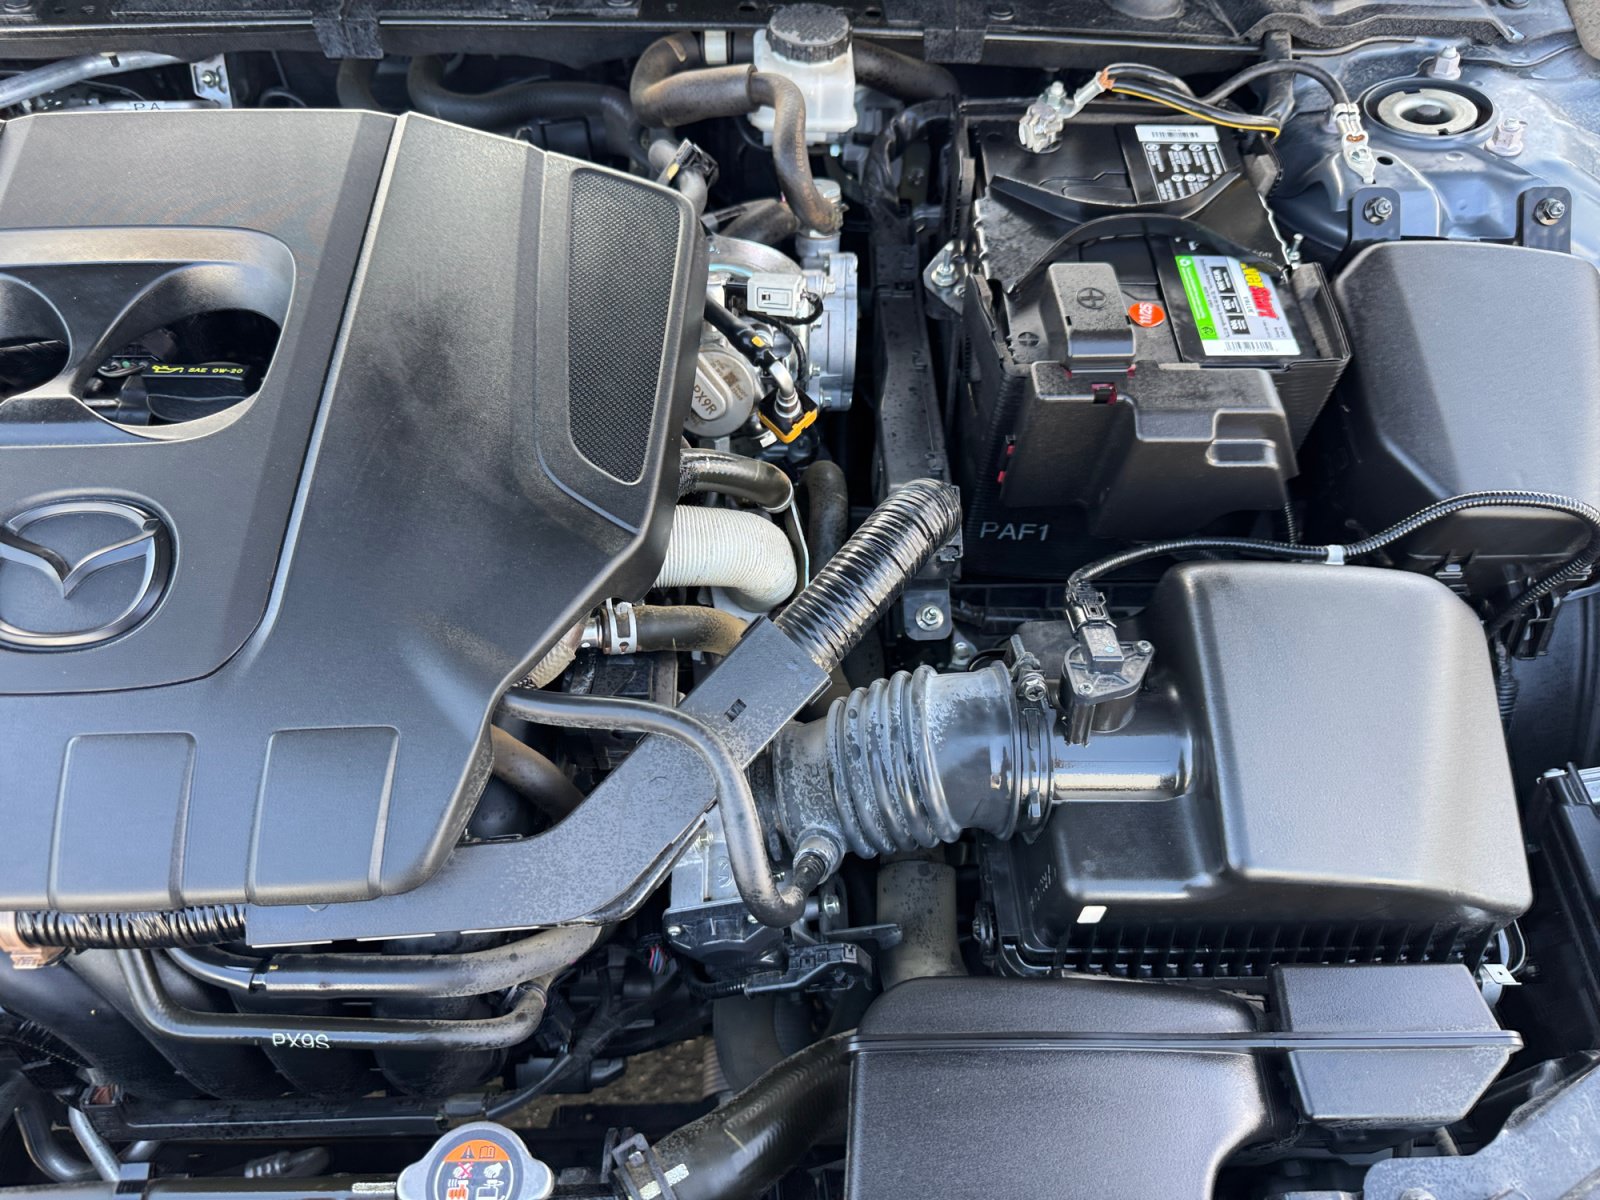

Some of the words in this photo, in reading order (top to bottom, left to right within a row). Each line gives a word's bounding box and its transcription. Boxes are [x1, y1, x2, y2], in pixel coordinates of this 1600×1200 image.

[1240, 263, 1279, 319] verStart
[979, 521, 1049, 542] PAF1
[271, 1032, 331, 1049] PX9S
